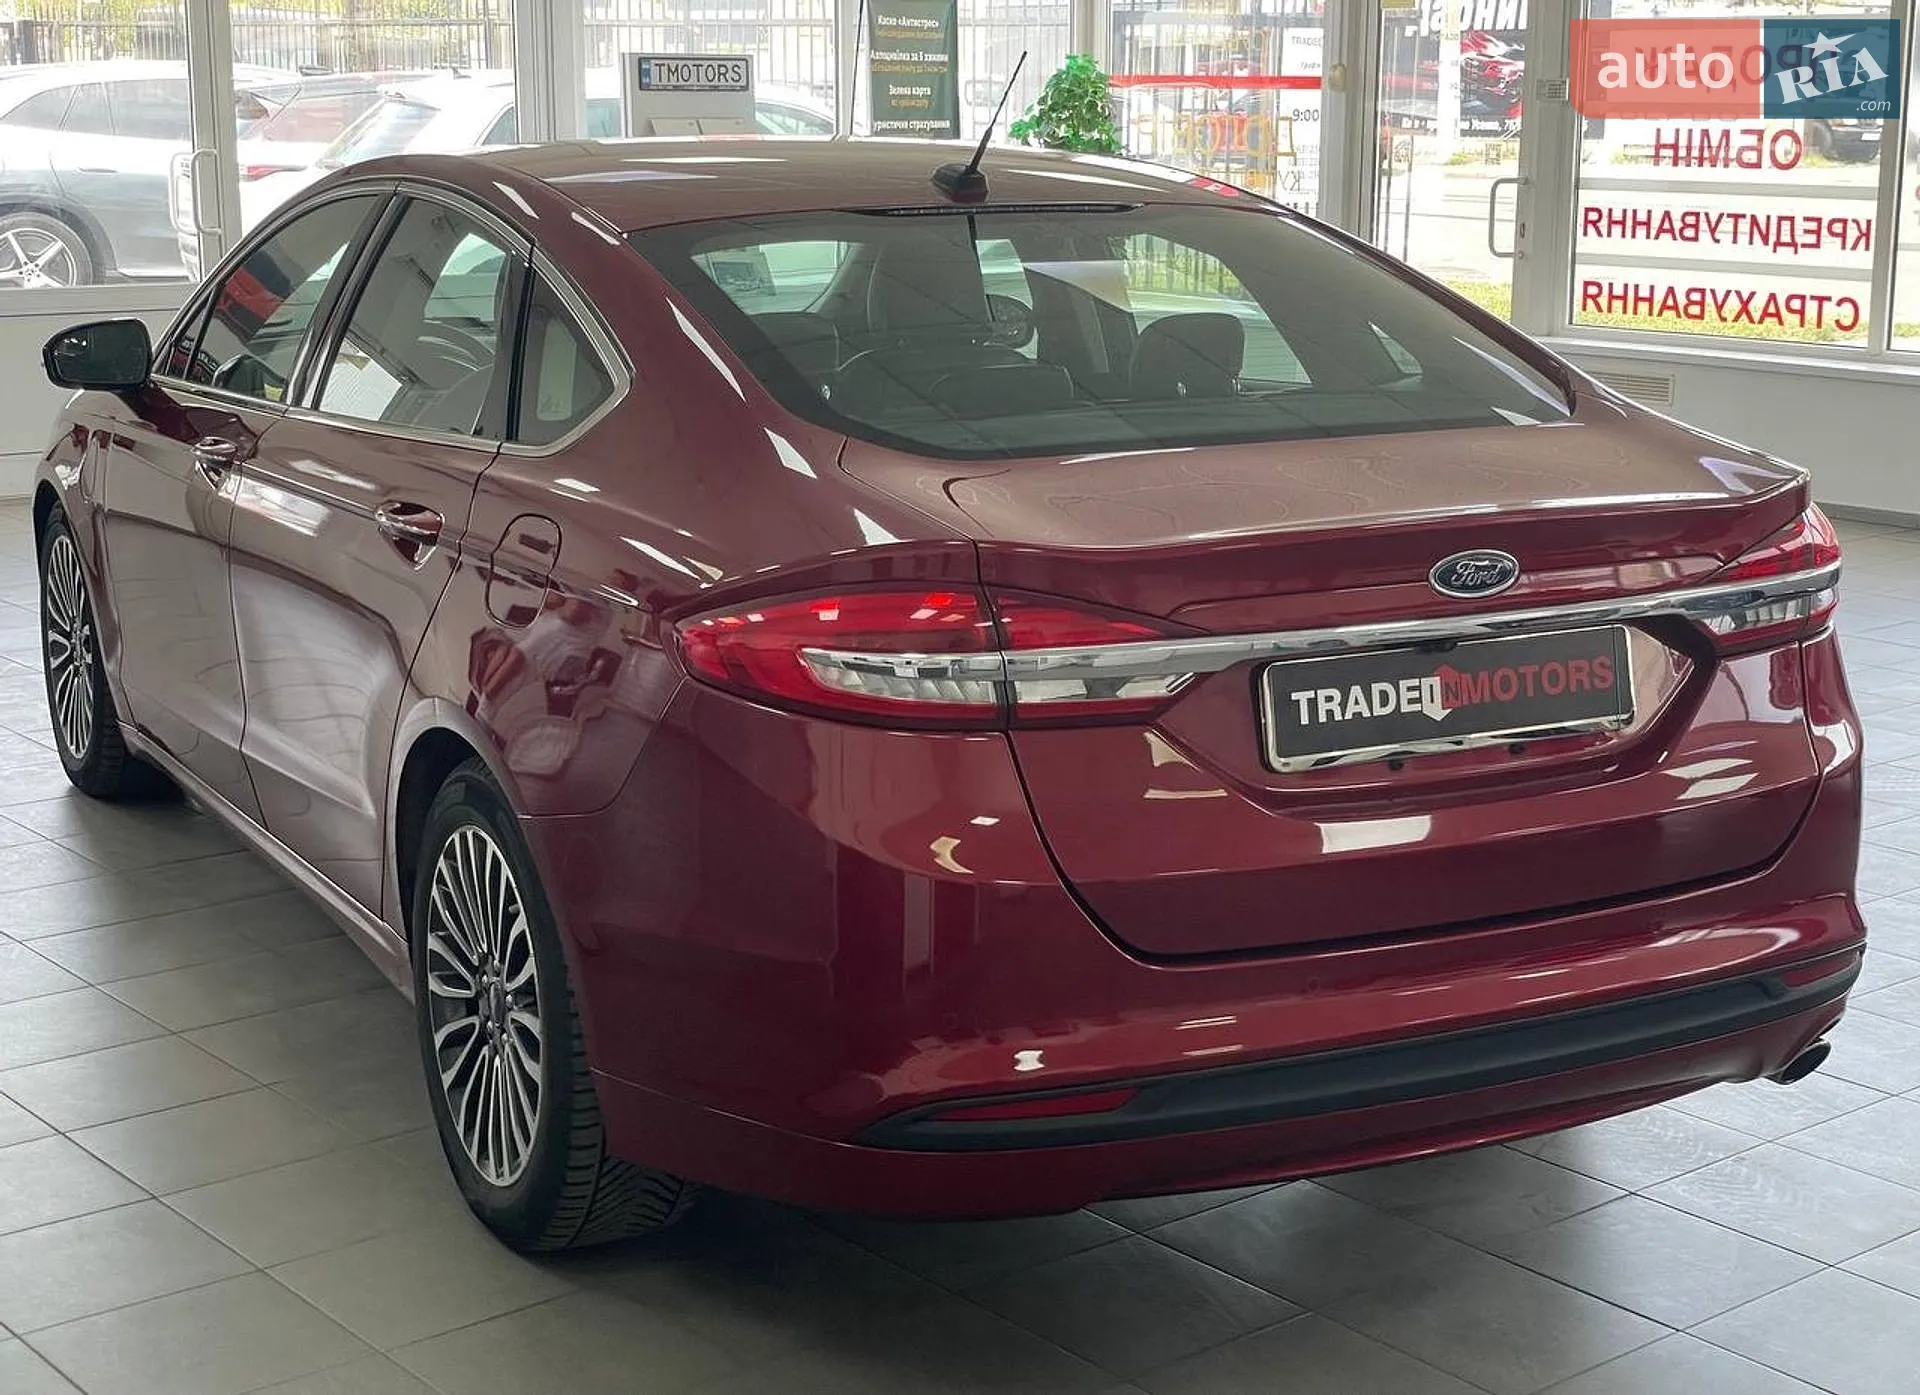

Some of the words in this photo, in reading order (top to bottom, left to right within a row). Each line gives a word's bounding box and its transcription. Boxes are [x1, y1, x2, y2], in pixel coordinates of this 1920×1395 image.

[654, 63, 742, 83] TMOTORS
[1292, 108, 1320, 122] 9:00
[1450, 560, 1503, 587] Ford
